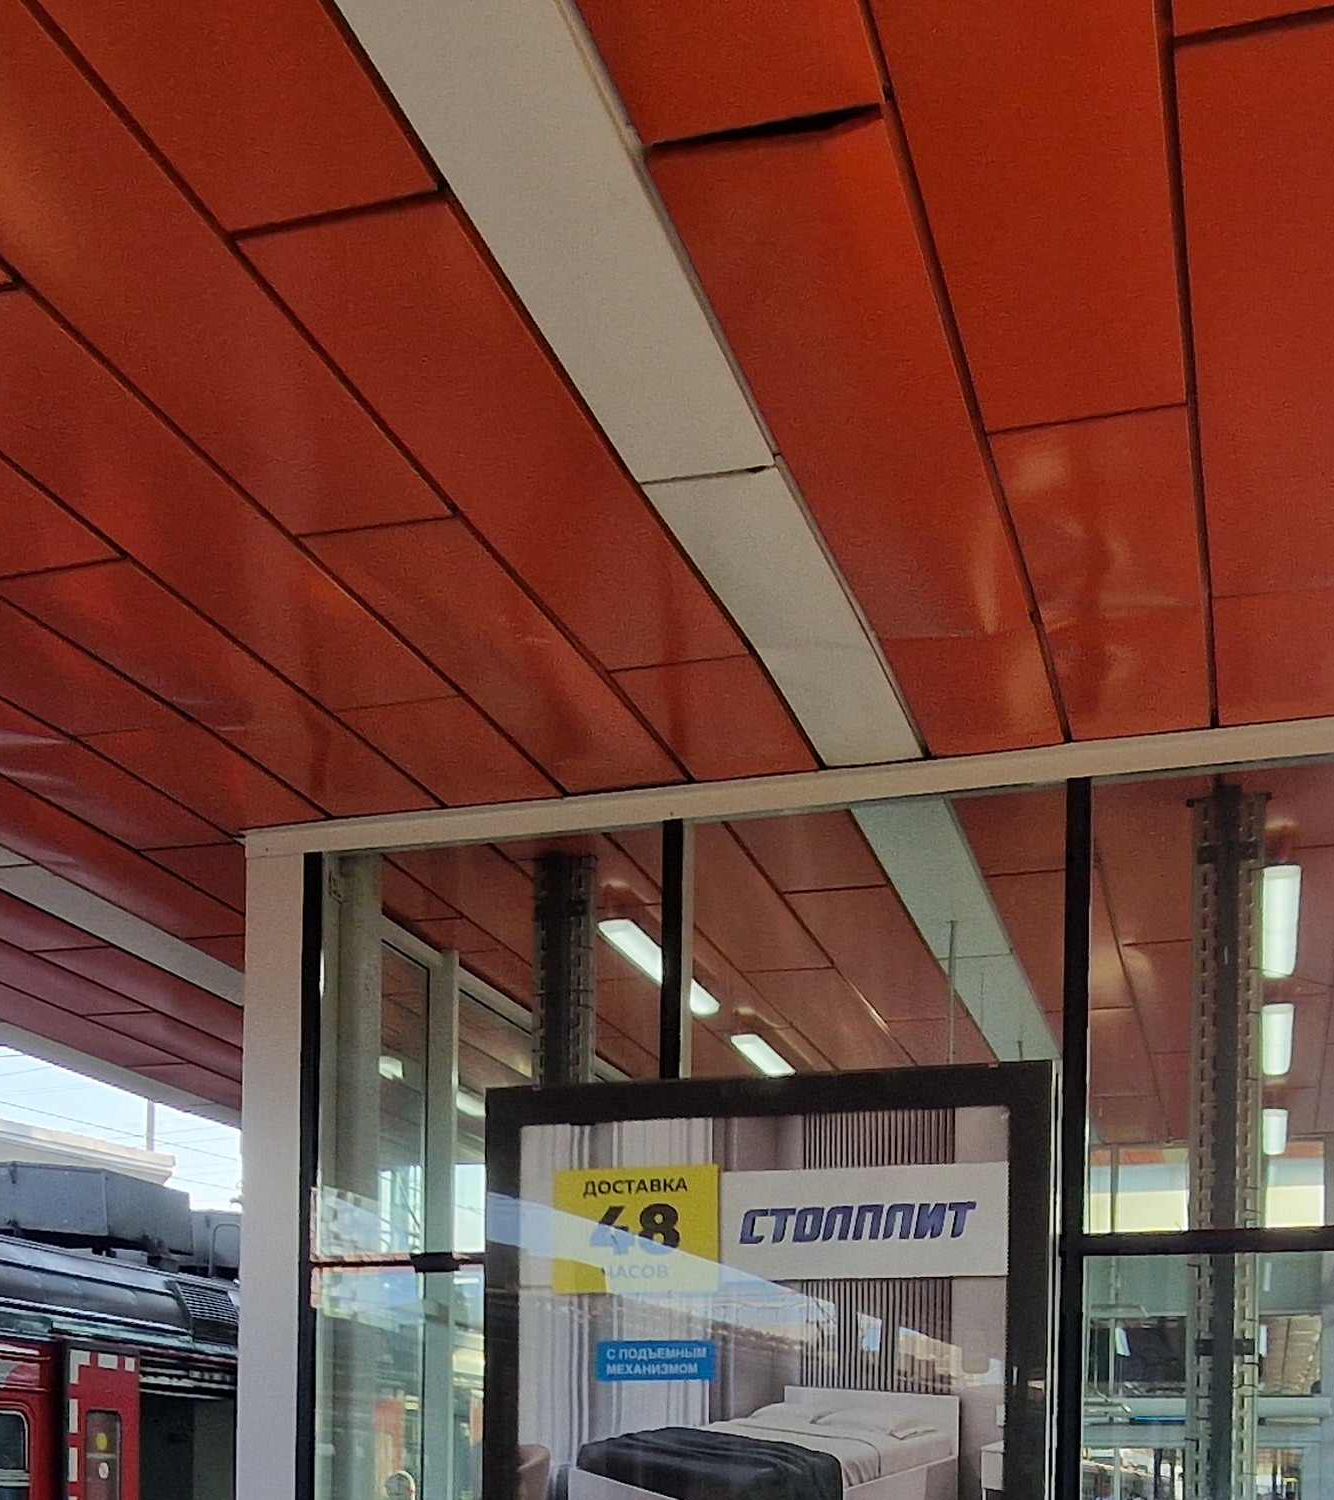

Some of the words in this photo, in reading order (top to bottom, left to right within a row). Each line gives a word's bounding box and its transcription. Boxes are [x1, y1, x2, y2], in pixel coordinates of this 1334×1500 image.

[583, 1177, 688, 1198] ДОСТАВКА
[590, 1203, 680, 1255] 48
[739, 1201, 977, 1245] СТОЛПЛИТ
[607, 1348, 616, 1360] С
[619, 1347, 707, 1361] ПОДЪЕМНЫМ
[607, 1363, 699, 1375] МЕХАНИЗМОМ
